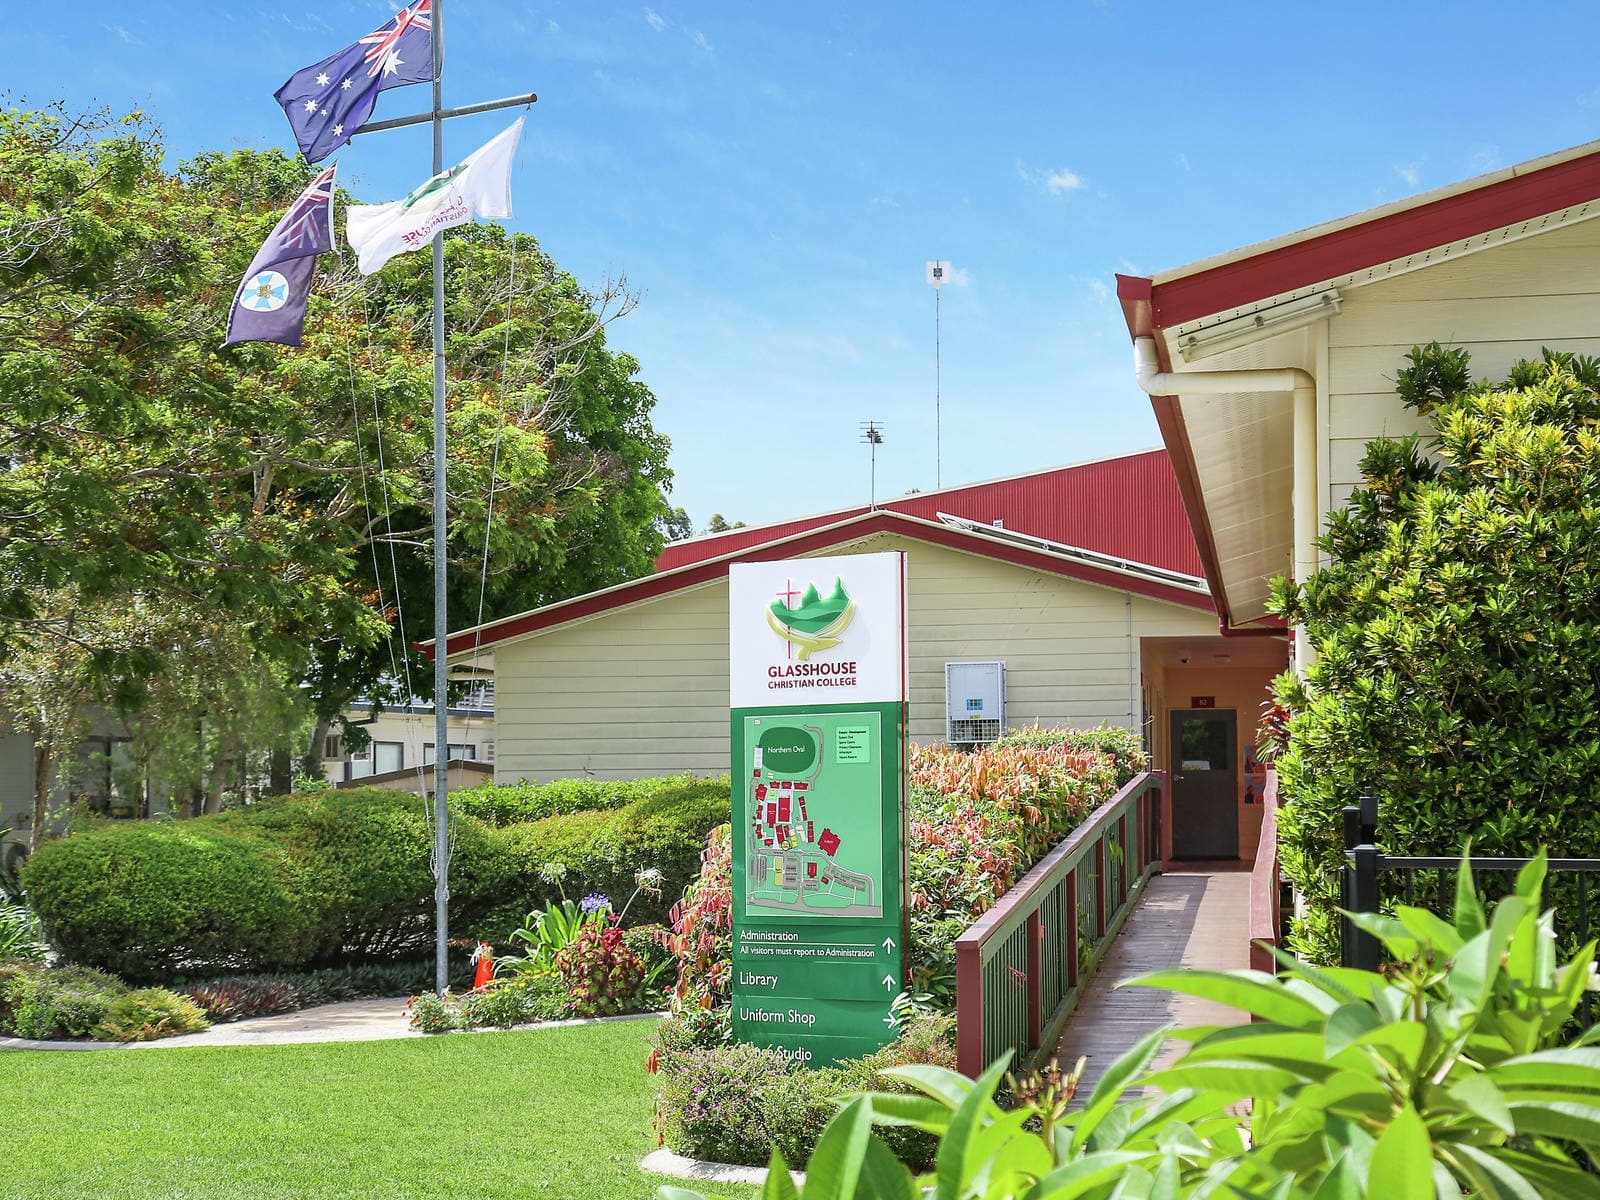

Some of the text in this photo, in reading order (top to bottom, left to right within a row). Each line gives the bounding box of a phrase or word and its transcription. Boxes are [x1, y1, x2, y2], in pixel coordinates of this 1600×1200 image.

[768, 661, 857, 678] GLASSHOUSE
[768, 677, 857, 690] CHRISTIAN COLLEGE
[767, 745, 805, 754] Northern Oval
[740, 929, 799, 941] Administration
[740, 945, 749, 954] All
[750, 946, 774, 955] visitors
[793, 948, 816, 958] report
[817, 948, 825, 956] to
[826, 946, 875, 958] Administration
[740, 971, 779, 989] Library
[740, 1007, 816, 1028] Uniform Shop
[776, 1045, 813, 1061] Studio
